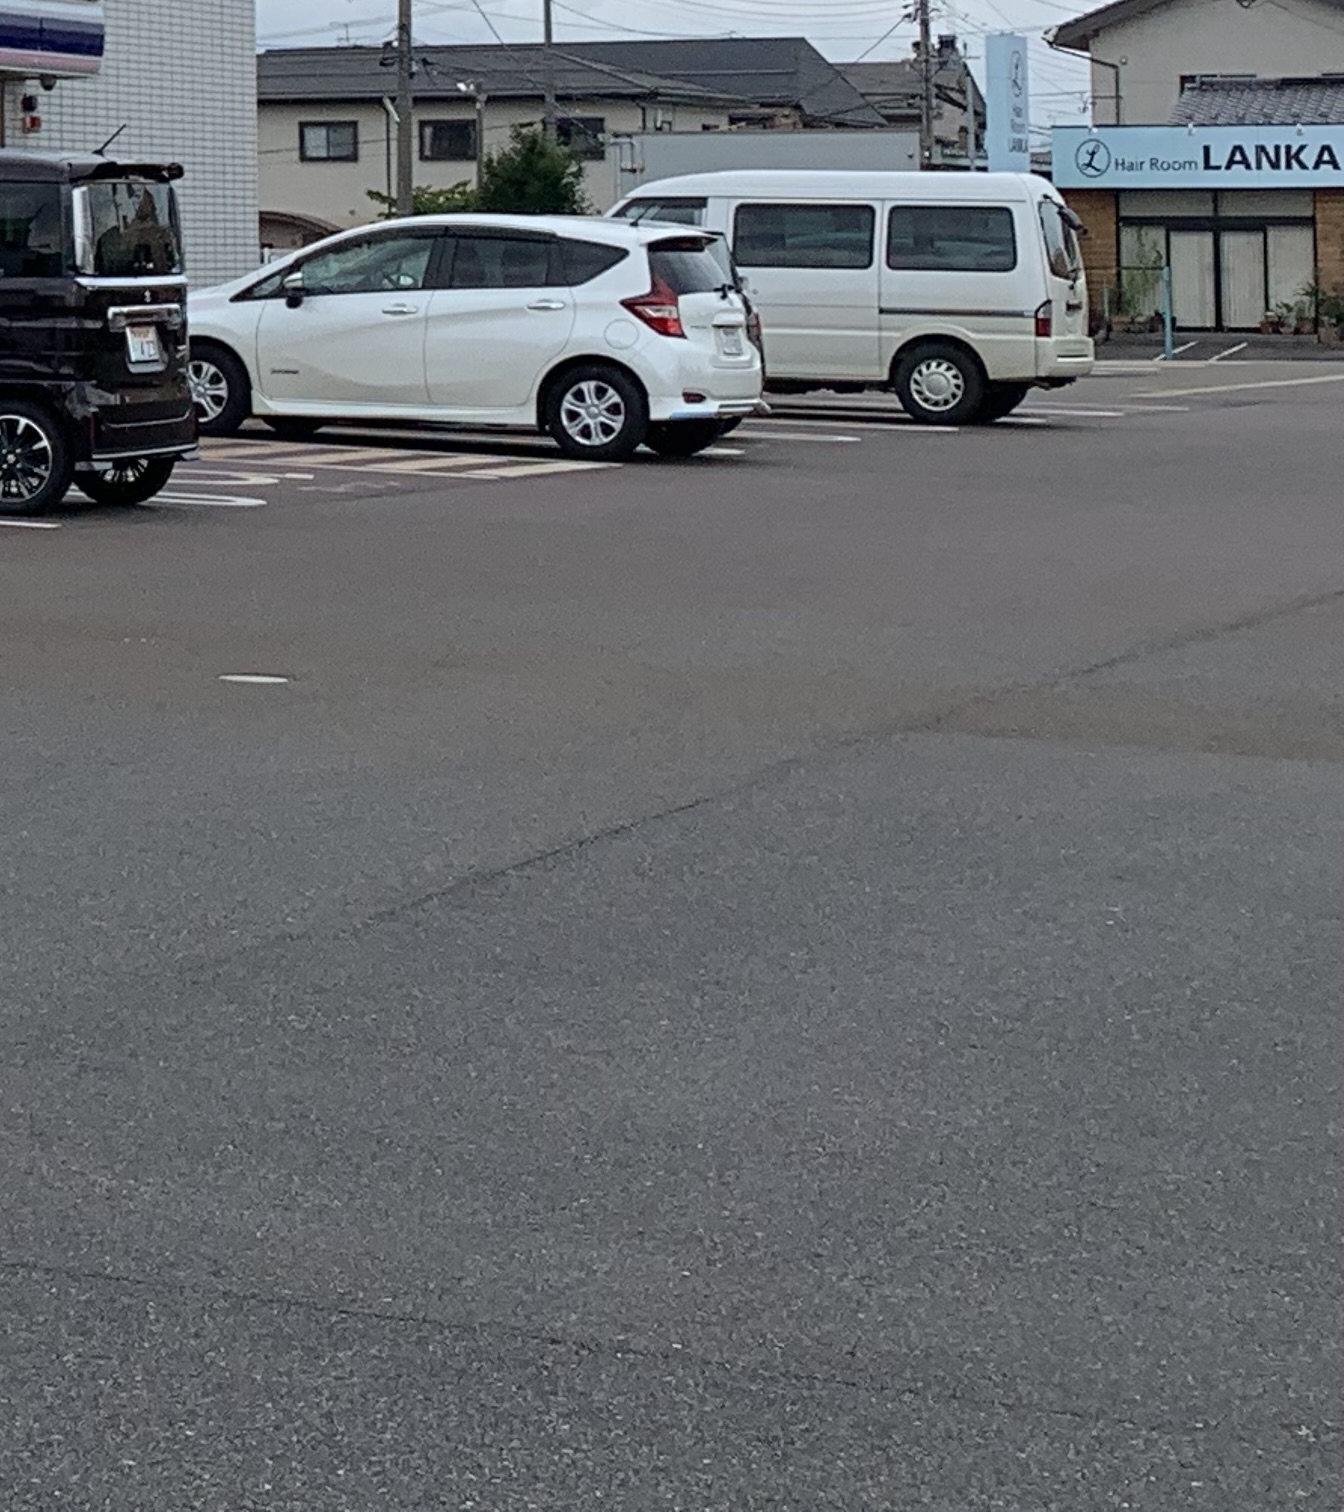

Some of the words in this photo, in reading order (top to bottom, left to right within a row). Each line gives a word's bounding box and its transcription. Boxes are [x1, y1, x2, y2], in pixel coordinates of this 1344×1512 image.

[1115, 157, 1144, 172] Hair
[1150, 157, 1198, 172] Room
[1202, 144, 1342, 171] LANKA
